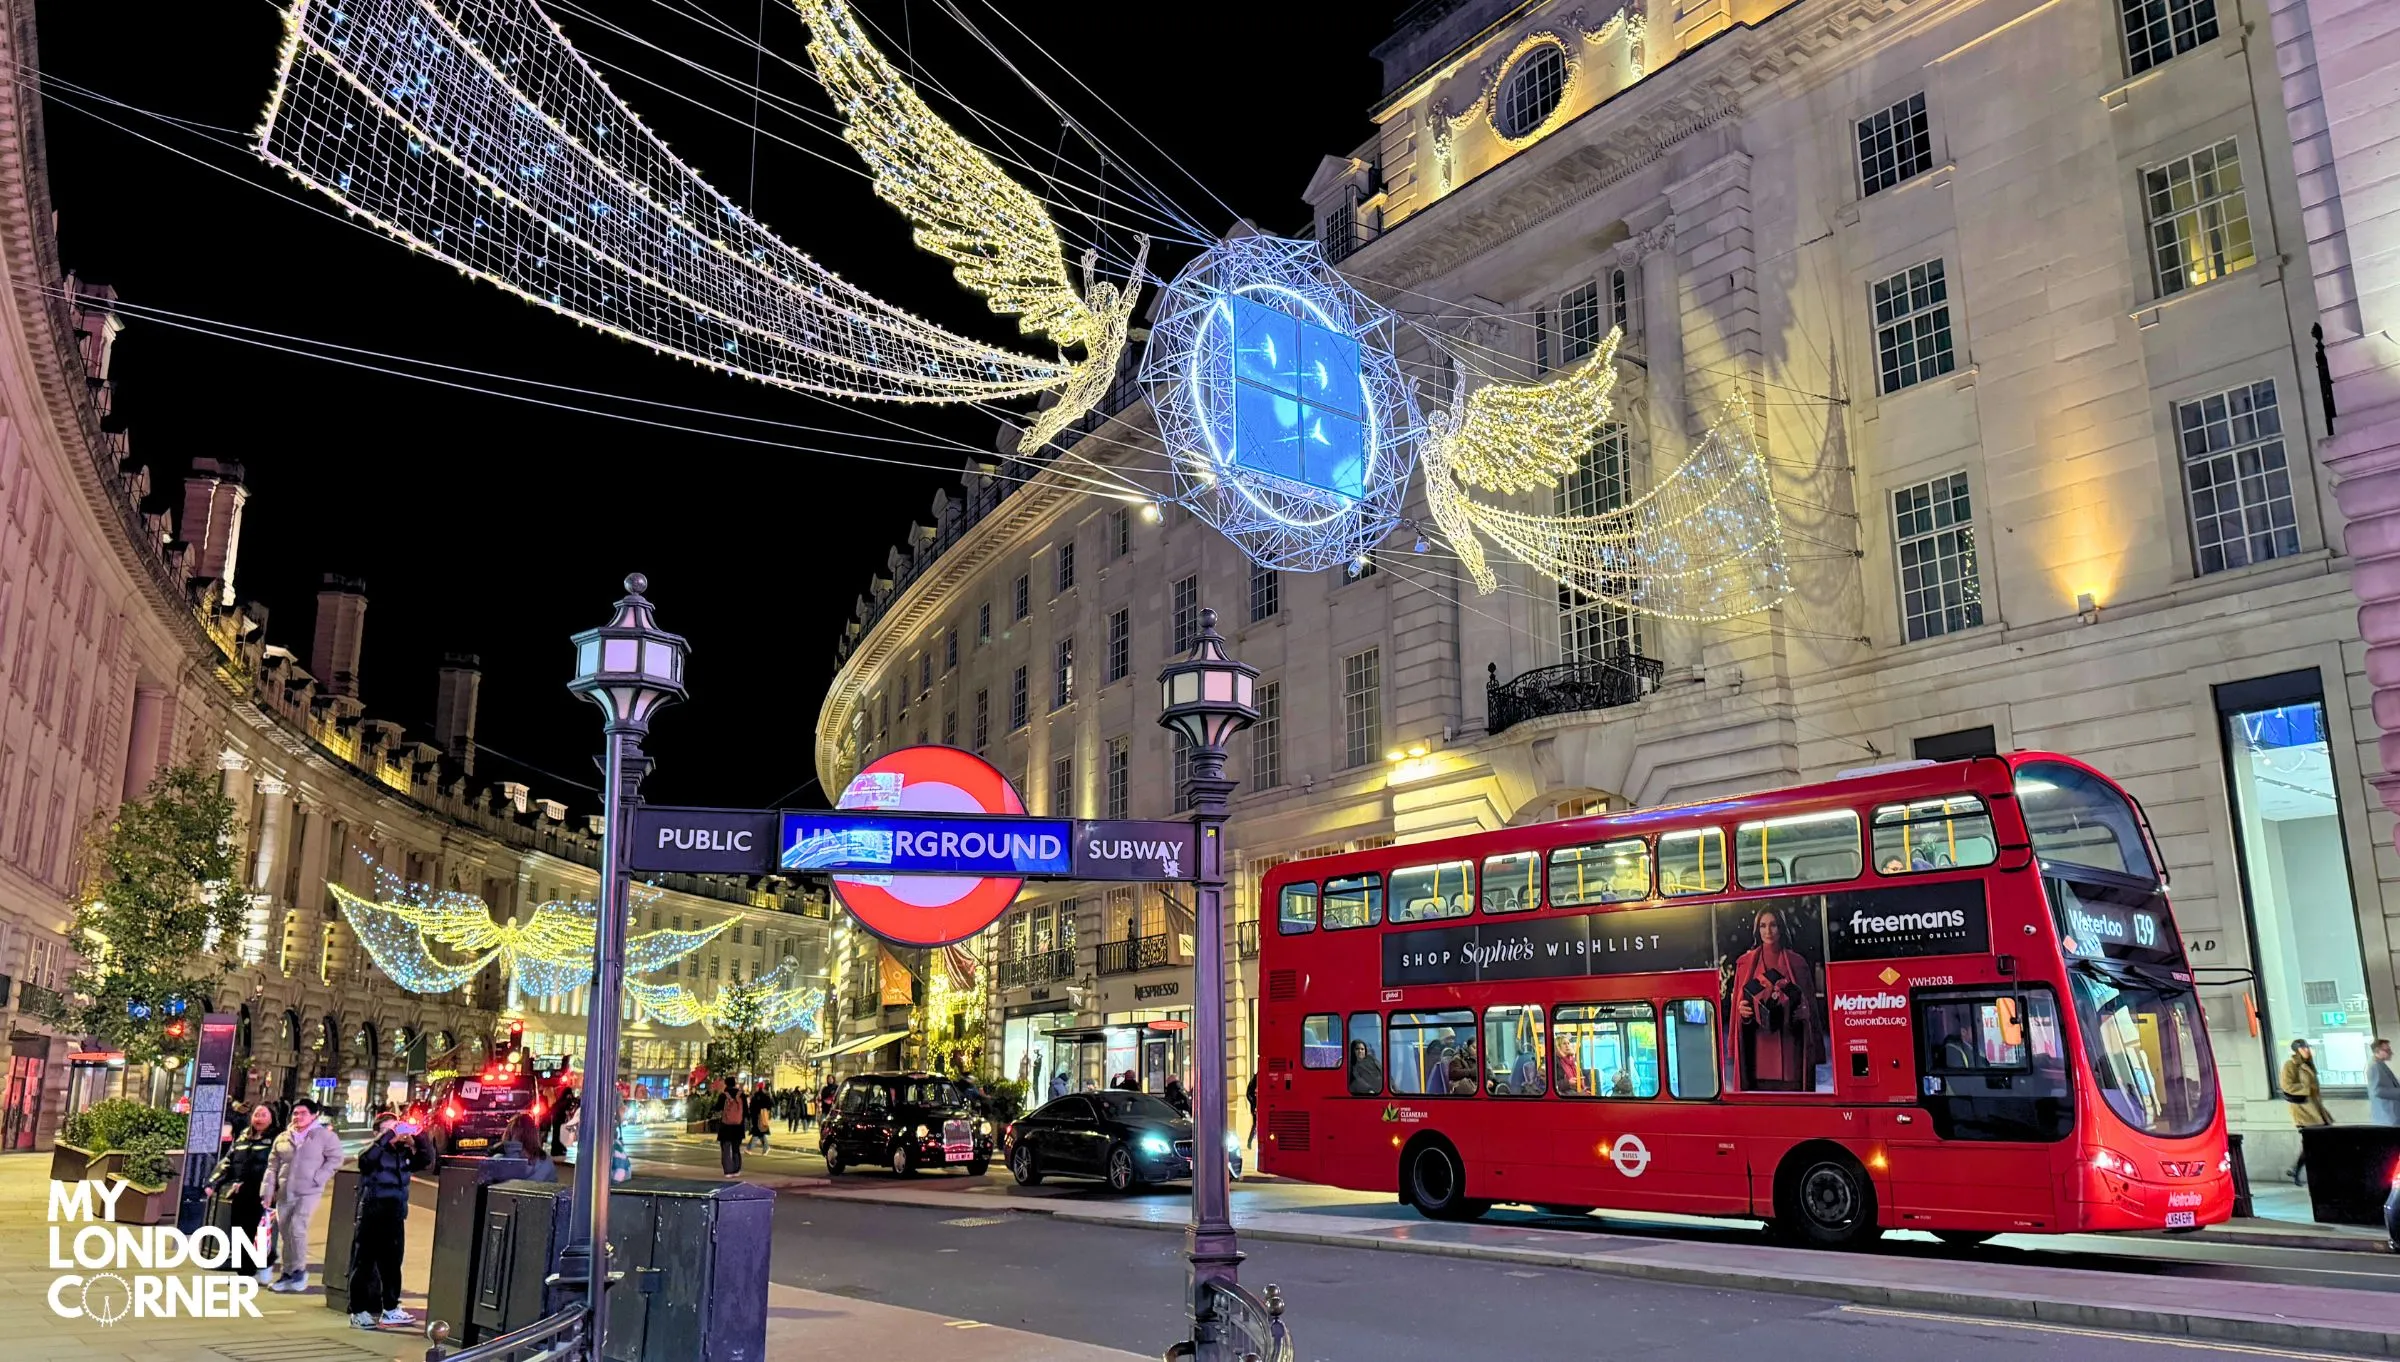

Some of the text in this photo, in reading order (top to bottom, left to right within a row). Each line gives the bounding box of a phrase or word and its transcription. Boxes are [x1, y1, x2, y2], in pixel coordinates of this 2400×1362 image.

[658, 828, 753, 852] PUBLIC
[795, 828, 1062, 861] UNRGROUND
[1088, 839, 1184, 860] SUBWAY
[1849, 910, 1965, 934] freemans
[2068, 909, 2155, 946] Waterloo 139
[1855, 931, 1966, 944] EXCLUSIVELY ONLINE
[1402, 935, 1660, 968] SHOP Sophie's WISHLIST
[1909, 976, 1953, 987] VWH2038
[1134, 982, 1179, 1002] NESPRESSO
[1833, 992, 1907, 1011] Metroline
[1842, 1111, 1853, 1121] W
[2168, 1191, 2203, 1207] Metroline
